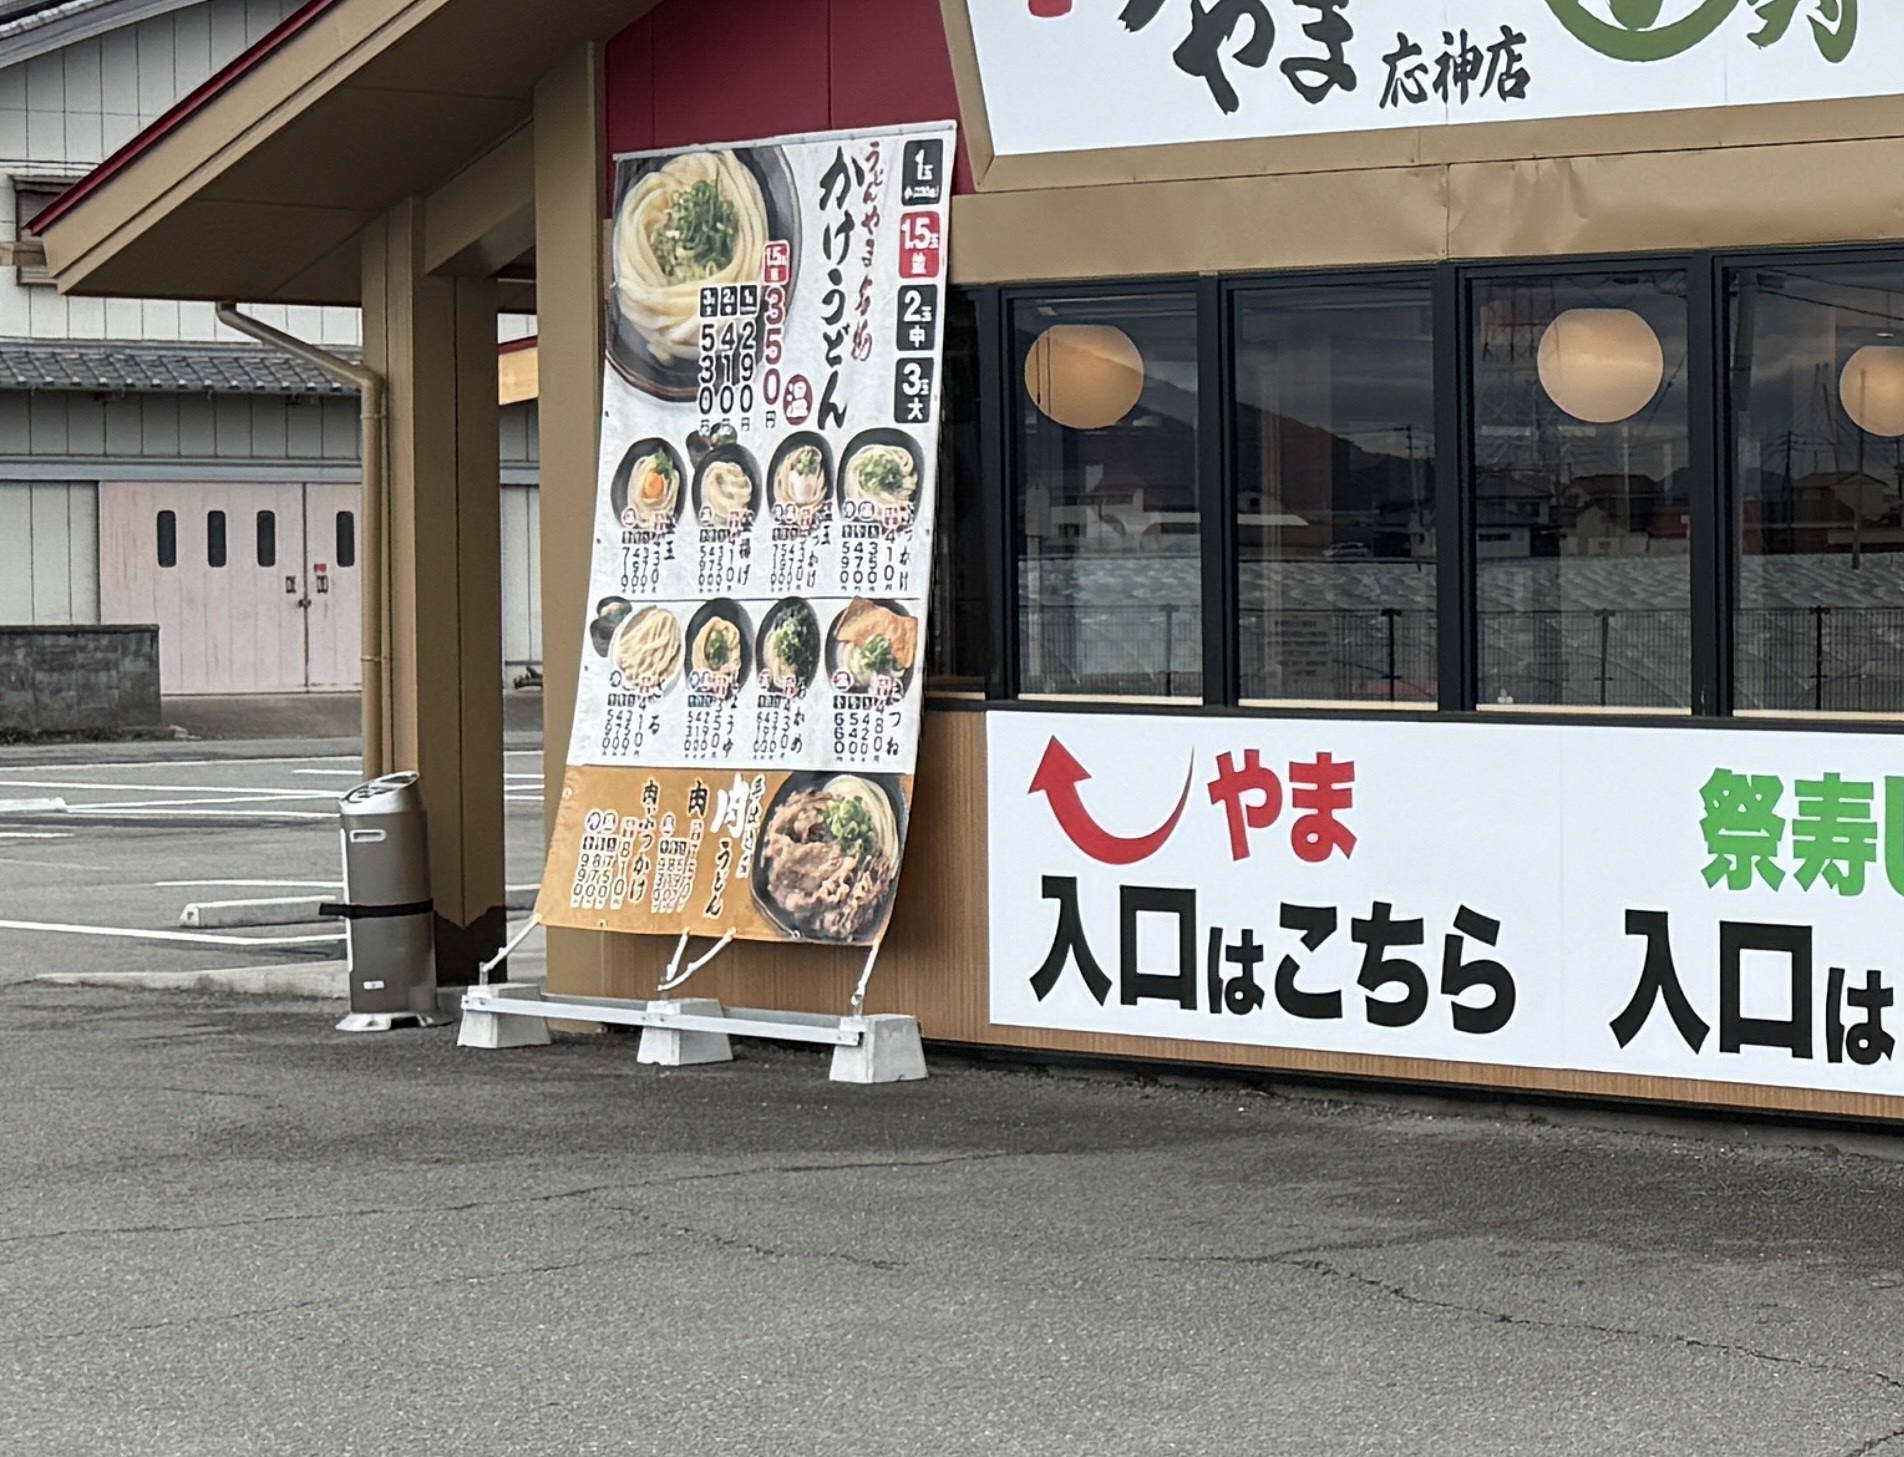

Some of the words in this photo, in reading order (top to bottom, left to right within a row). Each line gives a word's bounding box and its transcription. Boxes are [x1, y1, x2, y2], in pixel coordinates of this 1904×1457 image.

[1379, 27, 1530, 109] 応神店
[817, 145, 865, 430] かけうどん
[909, 325, 924, 348] 中
[907, 397, 923, 420] 大
[1207, 748, 1357, 862] やま
[1029, 875, 1517, 1034] 入口はこちら
